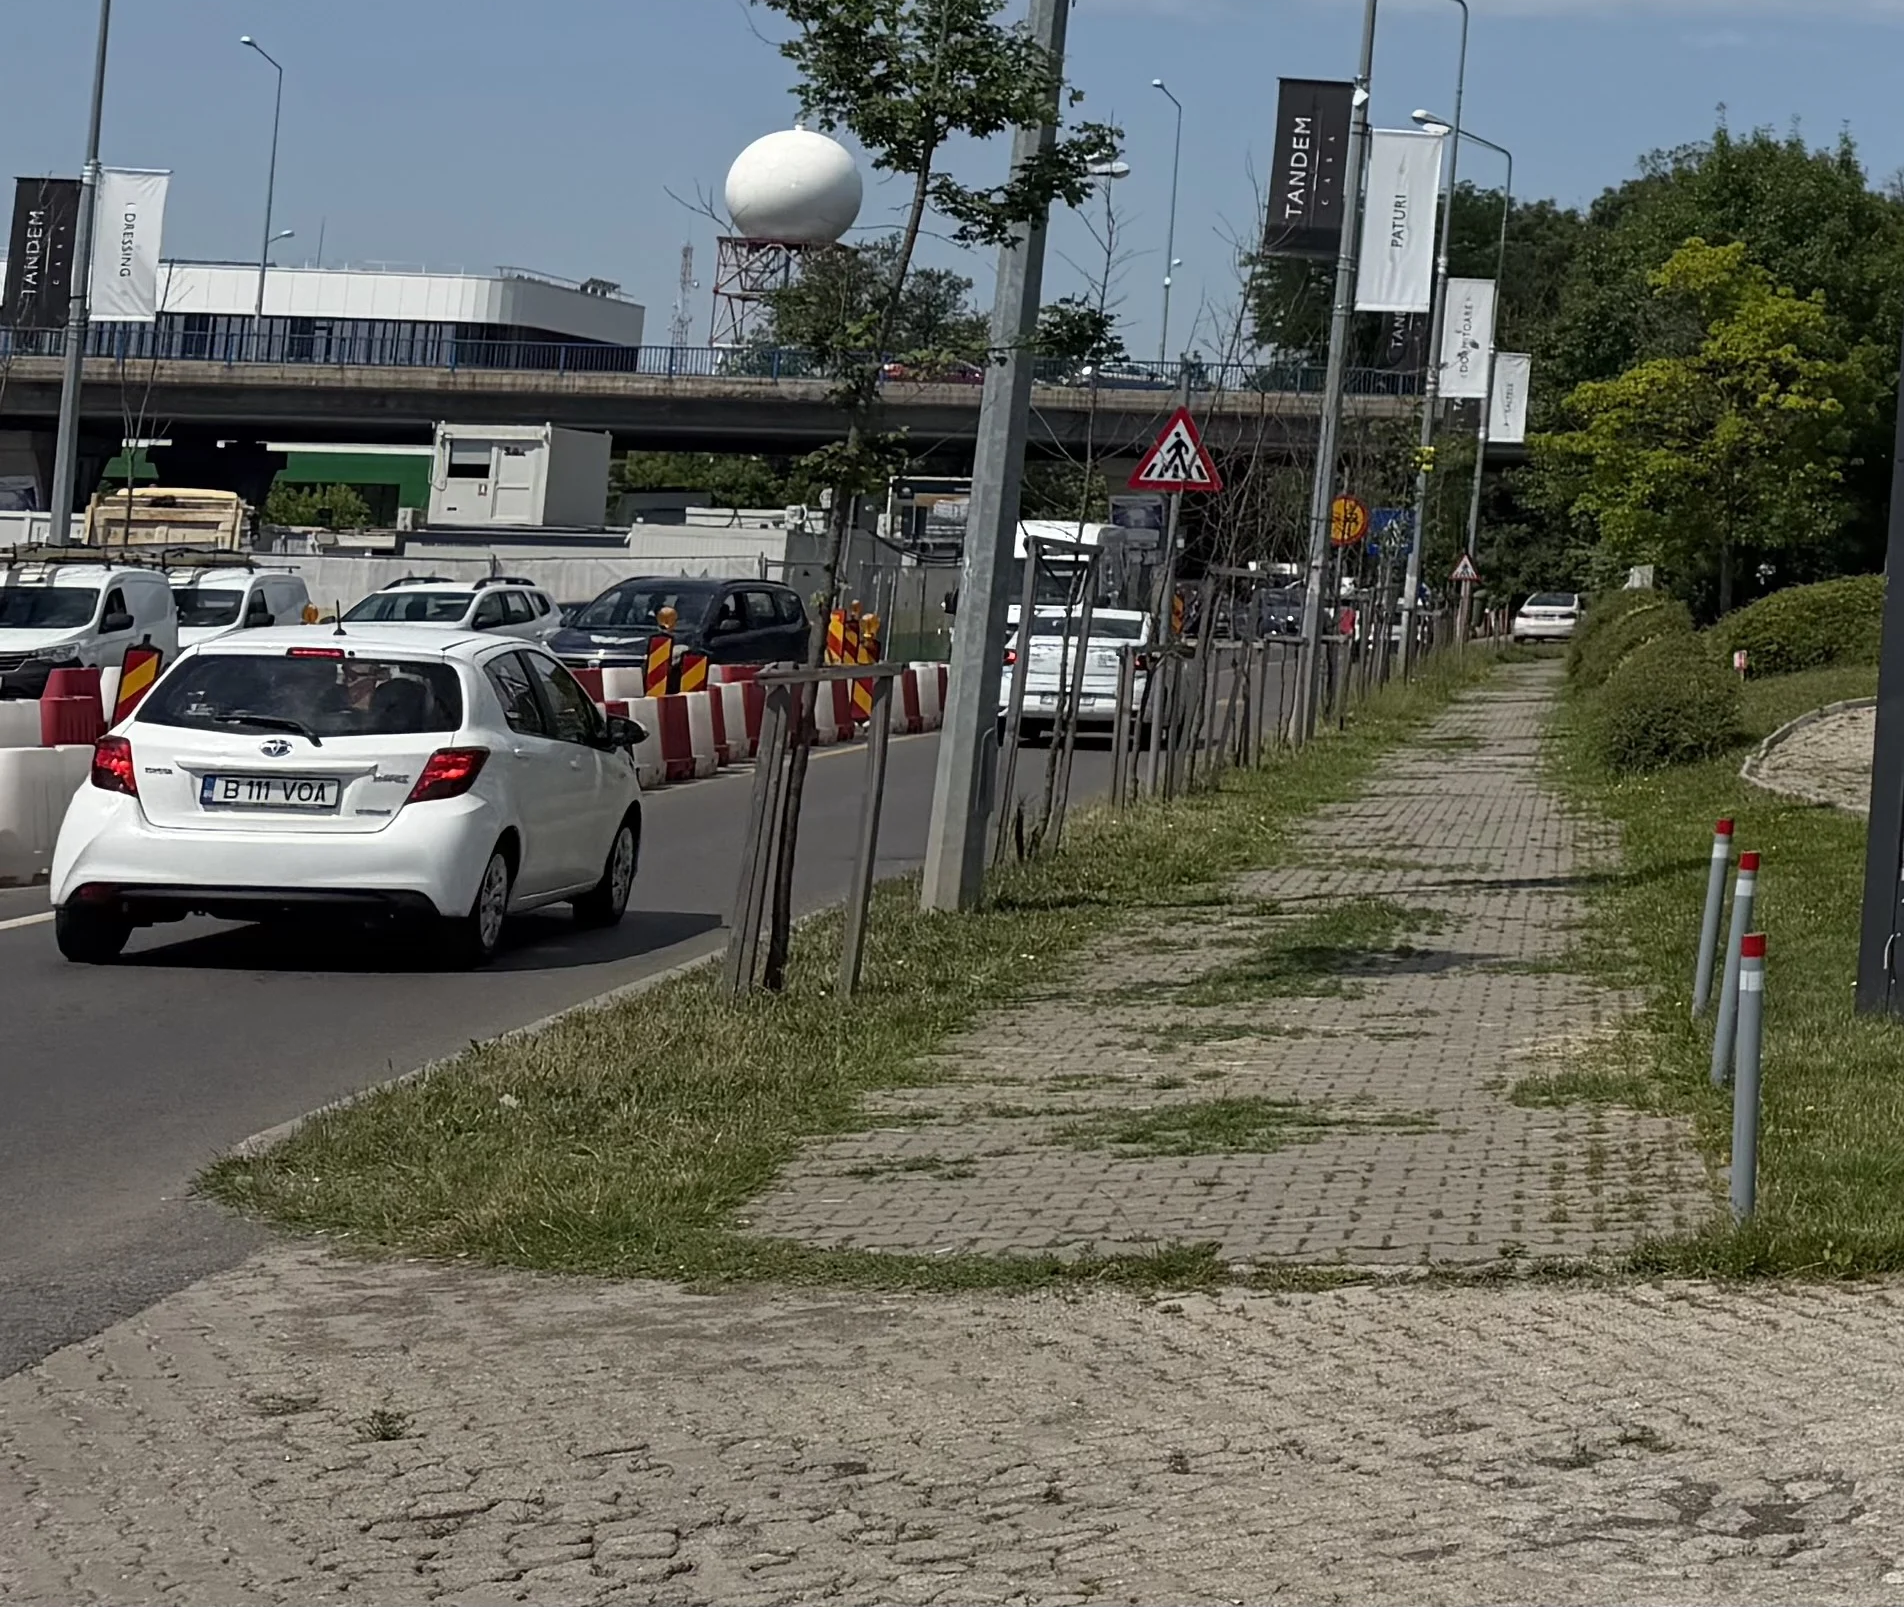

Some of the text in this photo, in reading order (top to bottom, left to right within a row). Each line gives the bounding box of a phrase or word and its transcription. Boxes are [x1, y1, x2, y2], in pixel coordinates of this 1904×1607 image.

[1284, 116, 1312, 220] TANDEM
[21, 210, 45, 295] TANDEM
[119, 212, 137, 278] DRESSING
[1390, 193, 1407, 248] PATURI
[223, 779, 327, 803] B 111 VOA
